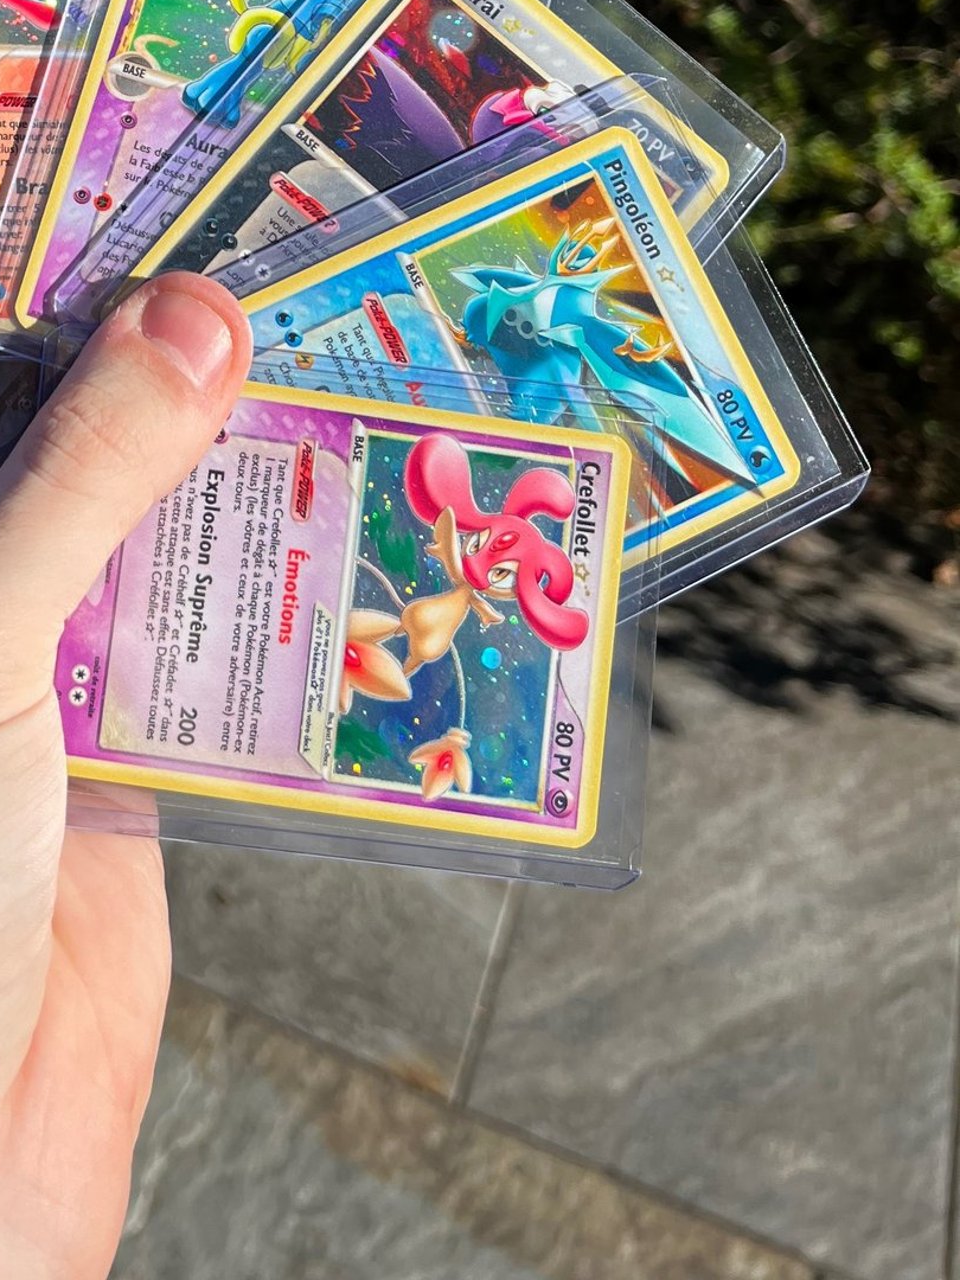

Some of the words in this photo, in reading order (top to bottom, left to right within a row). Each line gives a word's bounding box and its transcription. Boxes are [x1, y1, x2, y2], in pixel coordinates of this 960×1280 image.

[122, 63, 146, 78] BASE
[9, 121, 27, 130] que
[132, 140, 151, 154] Les
[295, 129, 319, 151] BASE
[646, 137, 675, 165] PV
[128, 154, 138, 166] la
[123, 171, 142, 183] sur
[276, 206, 297, 226] Une
[597, 156, 665, 263] Pingoléon
[267, 217, 289, 237] vous
[405, 262, 423, 289] BASE
[337, 329, 350, 344] de
[350, 322, 369, 346] Tant
[715, 387, 740, 416] 80
[728, 415, 754, 445] PV
[352, 435, 363, 462] BASE
[236, 451, 248, 479] deux
[246, 453, 261, 492] exclus)
[276, 458, 288, 481] Tant
[255, 465, 271, 518] marqueur
[270, 484, 283, 504] que
[294, 442, 312, 518] Poké-POWER
[170, 495, 181, 523] cette
[184, 487, 197, 519] n'avez
[232, 481, 243, 513] tours.
[244, 496, 257, 515] (les
[572, 460, 600, 557] Crefollet
[193, 468, 224, 566] Explosion
[257, 522, 267, 536] de
[153, 506, 168, 558] attachées
[179, 523, 191, 542] pas
[242, 518, 255, 554] vôtres
[268, 507, 284, 556] Crefollet
[163, 526, 178, 567] attaque
[180, 546, 190, 560] de
[251, 539, 265, 569] dégât
[240, 557, 249, 569] et
[163, 570, 172, 587] est
[174, 564, 189, 606] Créhelf
[237, 573, 247, 599] ceux
[264, 581, 274, 597] est
[160, 590, 170, 613] sans
[235, 604, 245, 617] de
[245, 581, 261, 621] chaque
[277, 548, 311, 646] Émotions
[181, 572, 212, 663] Suprême
[260, 600, 272, 630] votre
[156, 616, 169, 643] effet.
[171, 628, 179, 640] et
[231, 622, 242, 652] votre
[242, 624, 257, 675] Pokémon
[254, 633, 270, 685] Pokémon
[149, 646, 166, 701] Défaussez
[164, 644, 180, 694] Créfadet
[222, 656, 240, 716] adversaire)
[249, 686, 264, 715] Actif,
[145, 704, 157, 740] toutes
[158, 716, 171, 742] dans
[176, 706, 197, 746] 200
[232, 679, 251, 753] (Pokémon-ex
[219, 720, 231, 751] entre
[246, 717, 260, 755] retirez
[302, 734, 311, 752] deck
[555, 721, 574, 747] 80
[550, 754, 570, 781] PV
